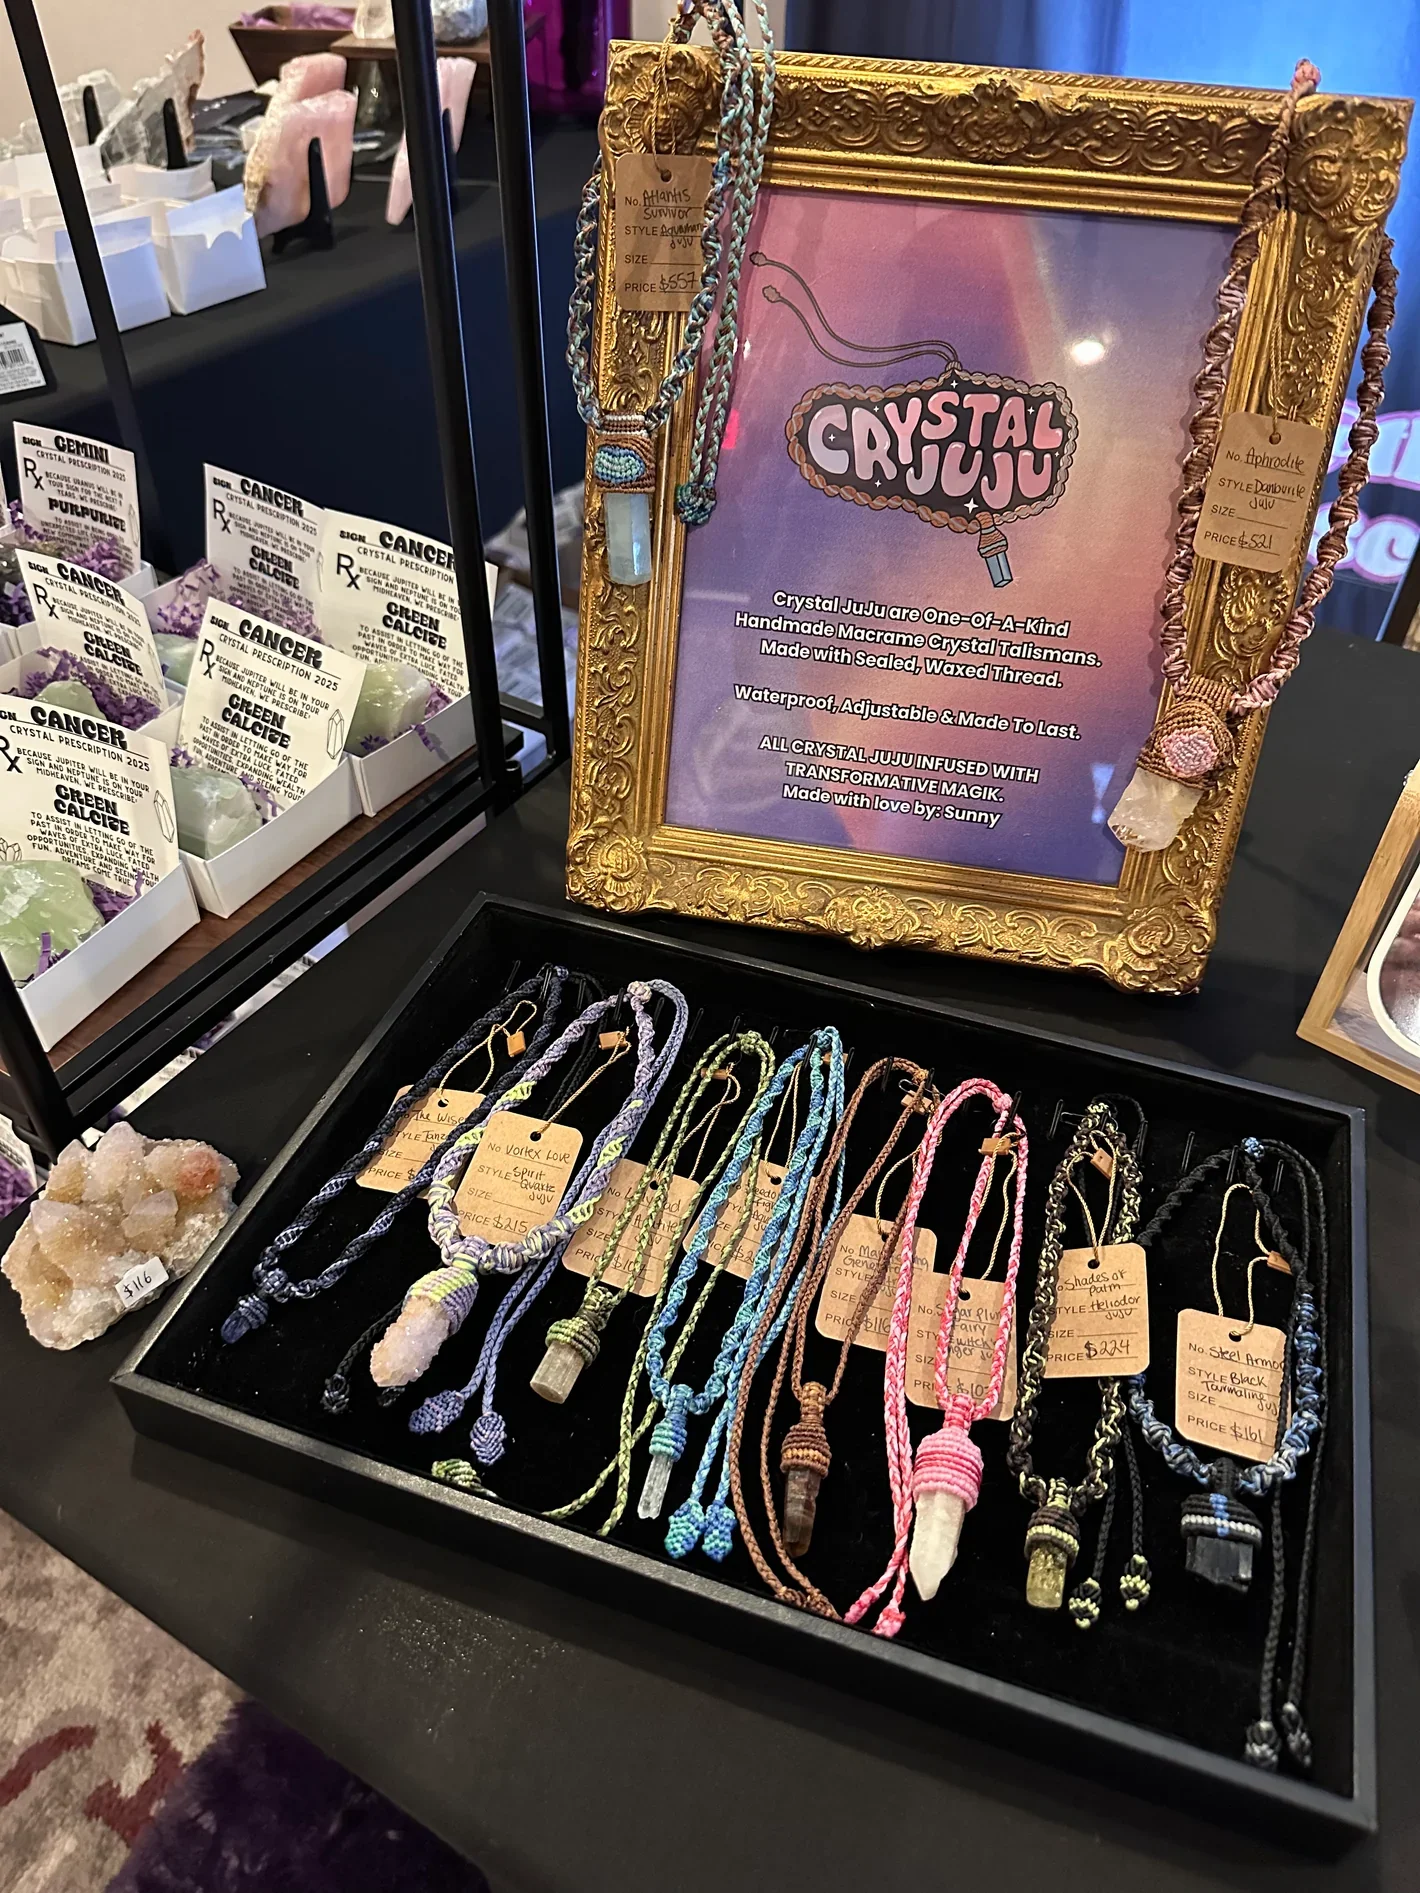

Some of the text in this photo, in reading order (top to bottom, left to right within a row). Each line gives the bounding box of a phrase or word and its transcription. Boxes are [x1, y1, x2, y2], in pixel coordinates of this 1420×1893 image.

[625, 188, 690, 206] No. Atlantis
[644, 208, 692, 220] Survivor
[625, 226, 658, 235] STYLE
[625, 255, 648, 264] SIZE
[625, 271, 698, 293] PRICE $557
[54, 435, 109, 464] GEMINI
[807, 391, 1063, 481] CRYSTAL
[37, 450, 126, 482] CRYSTAL PRESCRIPTION 2025
[1226, 447, 1305, 473] No. Aphrodite
[905, 441, 1052, 510] JUJU
[1218, 478, 1305, 498] STYLE Danburite
[241, 479, 304, 517] CANCER
[1211, 505, 1236, 517] SIZE
[48, 498, 126, 532] PURPURITE
[226, 493, 317, 536] CRYSTAL PRESCRIPTION 2025
[339, 530, 366, 543] SIGN
[1204, 531, 1273, 549] PRICE $521
[251, 545, 293, 573] GREEN
[357, 547, 454, 585] CRYSTAL PRESCRIPTION
[57, 563, 125, 607] CANCER
[249, 558, 299, 589] CALCITE
[45, 577, 141, 627] CRYSTAL PRESCRIPTION 2025
[773, 590, 1070, 638] Crystal JuJu are One-Of-A-Kind
[386, 601, 440, 632] GREEN
[83, 631, 132, 660] GREEN
[210, 615, 323, 670] SIGN CANCER
[382, 614, 448, 650] CALCITE
[734, 611, 1102, 667] Handmade Macrame Crystal Talismans.
[83, 643, 143, 677] CALCITE
[219, 633, 339, 692] CRYSTAL PRESCRIPTION 2025
[760, 639, 1063, 689] Made with Sealed, Waxed Thread.
[215, 654, 330, 711] BECAUSE JUPITER WILL BE IN YOUR
[219, 664, 320, 716] SIGN AND NEPTUNE IS ON YOUR
[228, 693, 287, 731] GREEN
[259, 693, 269, 704] WE
[733, 684, 1082, 740] Waterproof, Adjustable & Made To Last.
[30, 705, 128, 750] CANCER
[221, 706, 292, 749] CALCITE
[9, 724, 150, 772] CRYSTAL PRESCRIPTION 2025
[758, 735, 1040, 784] ALL CRYSTAL JUJU INFUSED WITH
[785, 761, 1005, 802] TRANSFORMATIVE MAGIK.
[55, 784, 119, 817] GREEN
[782, 784, 1002, 829] Made with love by: Sunny
[54, 798, 130, 836] CALCITE
[412, 1109, 430, 1121] The
[391, 1130, 422, 1141] STYLE
[378, 1150, 403, 1158] SIZE
[506, 1145, 541, 1160] Vortex
[546, 1150, 570, 1164] Love
[367, 1167, 404, 1179] PRICE
[478, 1165, 512, 1180] STYLE
[520, 1179, 555, 1192] Quartz
[467, 1187, 492, 1200] SIZE
[458, 1210, 529, 1233] PRICE $215
[586, 1228, 612, 1242] SIZE
[123, 1270, 153, 1299] $116
[835, 1267, 872, 1281] STYLE
[1064, 1272, 1110, 1290] Shades
[830, 1290, 856, 1303] SIZE
[1048, 1295, 1140, 1314] STYLE Heliodor
[918, 1305, 935, 1316] No.
[1048, 1330, 1074, 1338] SIZE
[915, 1354, 935, 1365] SIZ
[1046, 1339, 1129, 1361] PRICE $224
[1189, 1343, 1208, 1355] No.
[1209, 1346, 1240, 1360] Steel
[1188, 1367, 1268, 1387] STYLE Black
[1188, 1390, 1216, 1405] SIZE
[1201, 1381, 1266, 1401] Tourmaline
[1187, 1415, 1262, 1442] PRICE $161
